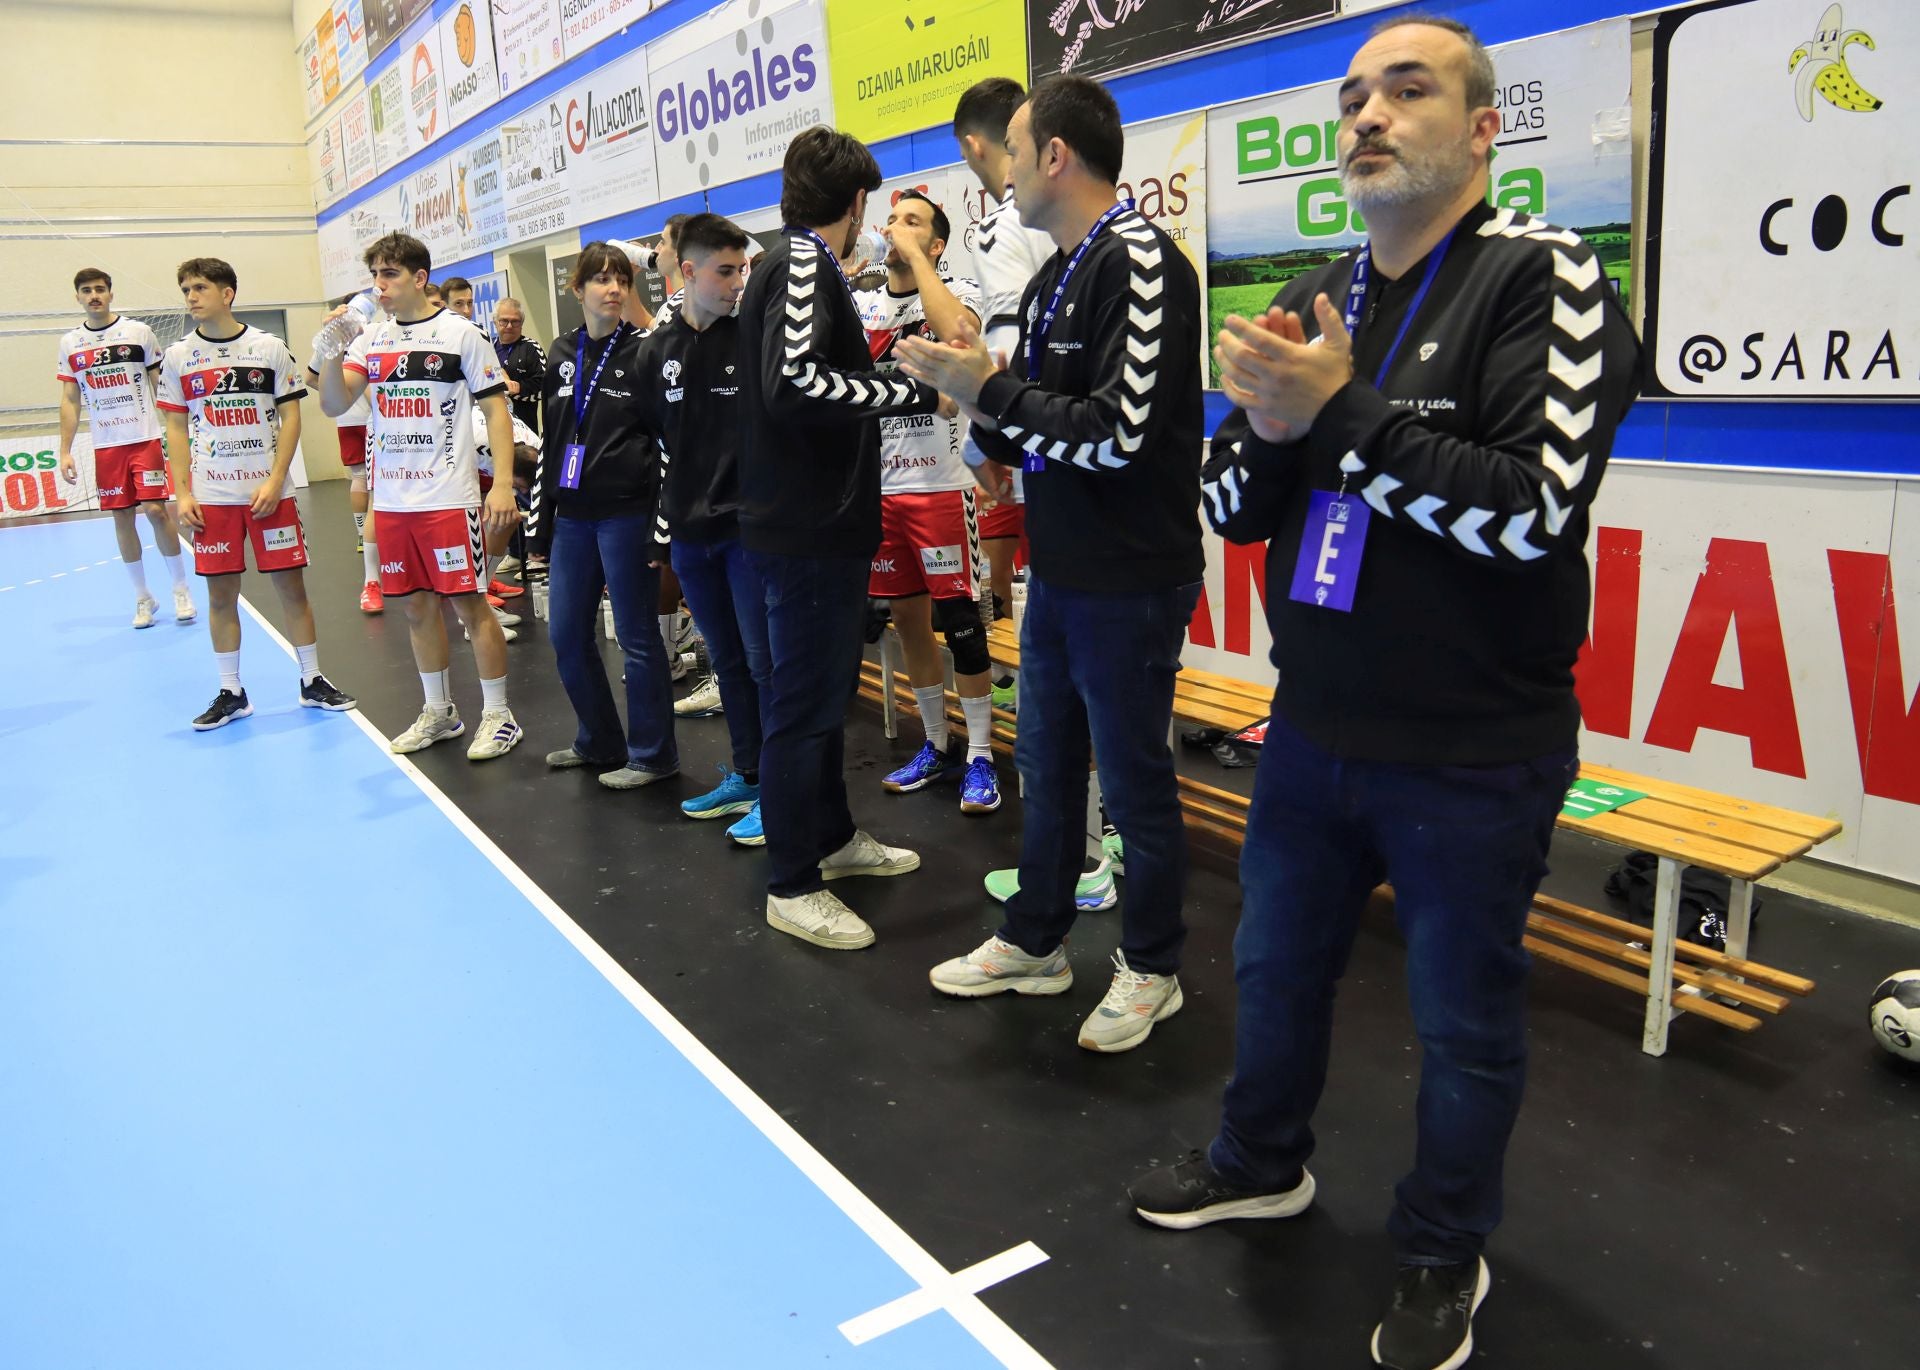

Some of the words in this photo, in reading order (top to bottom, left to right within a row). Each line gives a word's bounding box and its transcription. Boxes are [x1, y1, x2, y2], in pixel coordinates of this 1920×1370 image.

[1195, 9, 1214, 33] de
[857, 67, 904, 101] DIANA
[907, 34, 990, 84] MARUGÁN
[656, 43, 817, 143] Globales
[745, 107, 821, 145] Informática
[1498, 107, 1545, 133] LAS
[472, 138, 502, 171] HUMBERTO
[747, 141, 792, 161] www.glob
[415, 171, 438, 197] Viajes
[473, 169, 498, 198] MAESTRO
[540, 217, 547, 231] 96
[548, 214, 556, 228] 78
[93, 348, 111, 365] 53
[1678, 327, 1920, 384] @SARA
[93, 366, 126, 377] VIVEROS
[396, 354, 409, 379] 8
[94, 372, 130, 390] HEROL
[213, 368, 240, 392] 32
[386, 384, 430, 397] VIVEROS
[99, 394, 134, 407] cajaviva
[213, 396, 256, 408] VIVEROS
[387, 397, 433, 418] HEROL
[1426, 397, 1456, 410] LEÓN
[214, 407, 260, 428] HEROL
[217, 437, 265, 453] cajaviva
[386, 431, 434, 447] cajaviva
[445, 418, 456, 470] POLISAC
[0, 471, 67, 513] OL
[195, 542, 231, 554] EvolK
[1314, 521, 1346, 586] E
[926, 559, 960, 568] HERRERO
[954, 627, 975, 638] SELECT
